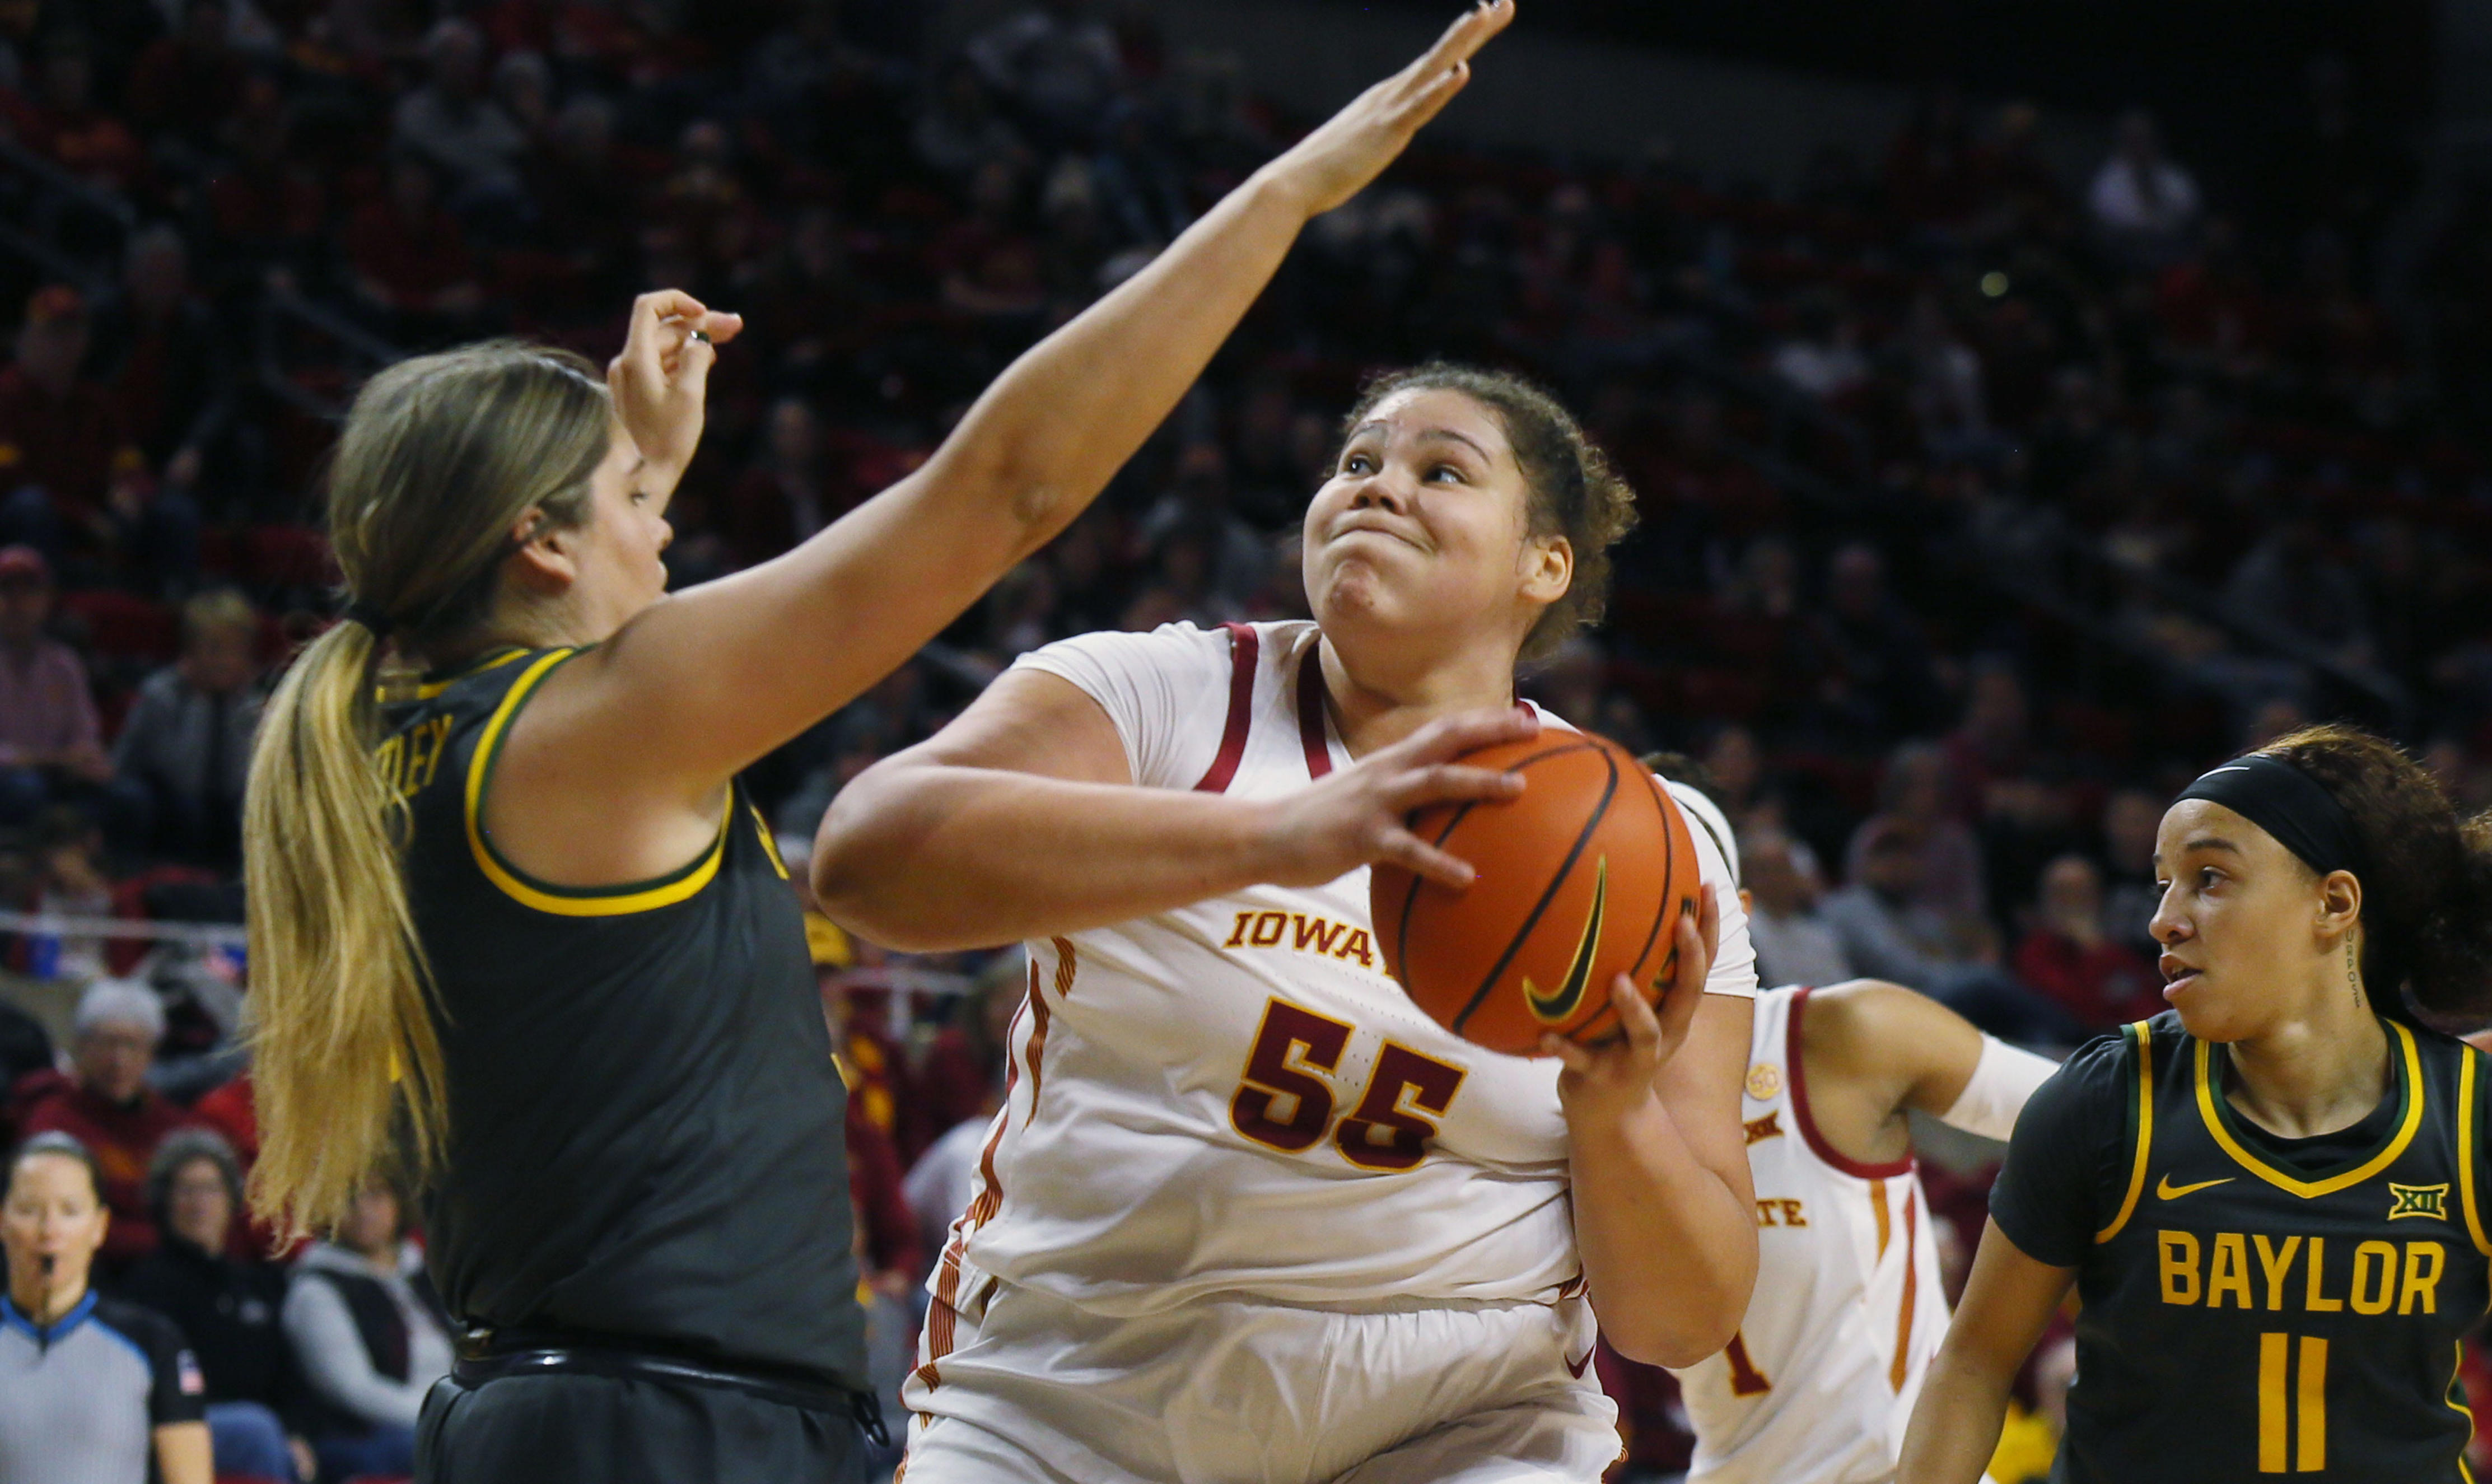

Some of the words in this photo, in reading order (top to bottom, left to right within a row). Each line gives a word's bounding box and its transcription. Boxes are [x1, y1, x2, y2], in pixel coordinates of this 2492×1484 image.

[1222, 910, 1374, 969] IOWA
[1228, 995, 1468, 1174] 55
[2387, 1182, 2450, 1221] XII
[2158, 1230, 2445, 1315] BAYLOR
[2258, 1332, 2328, 1473] 11
